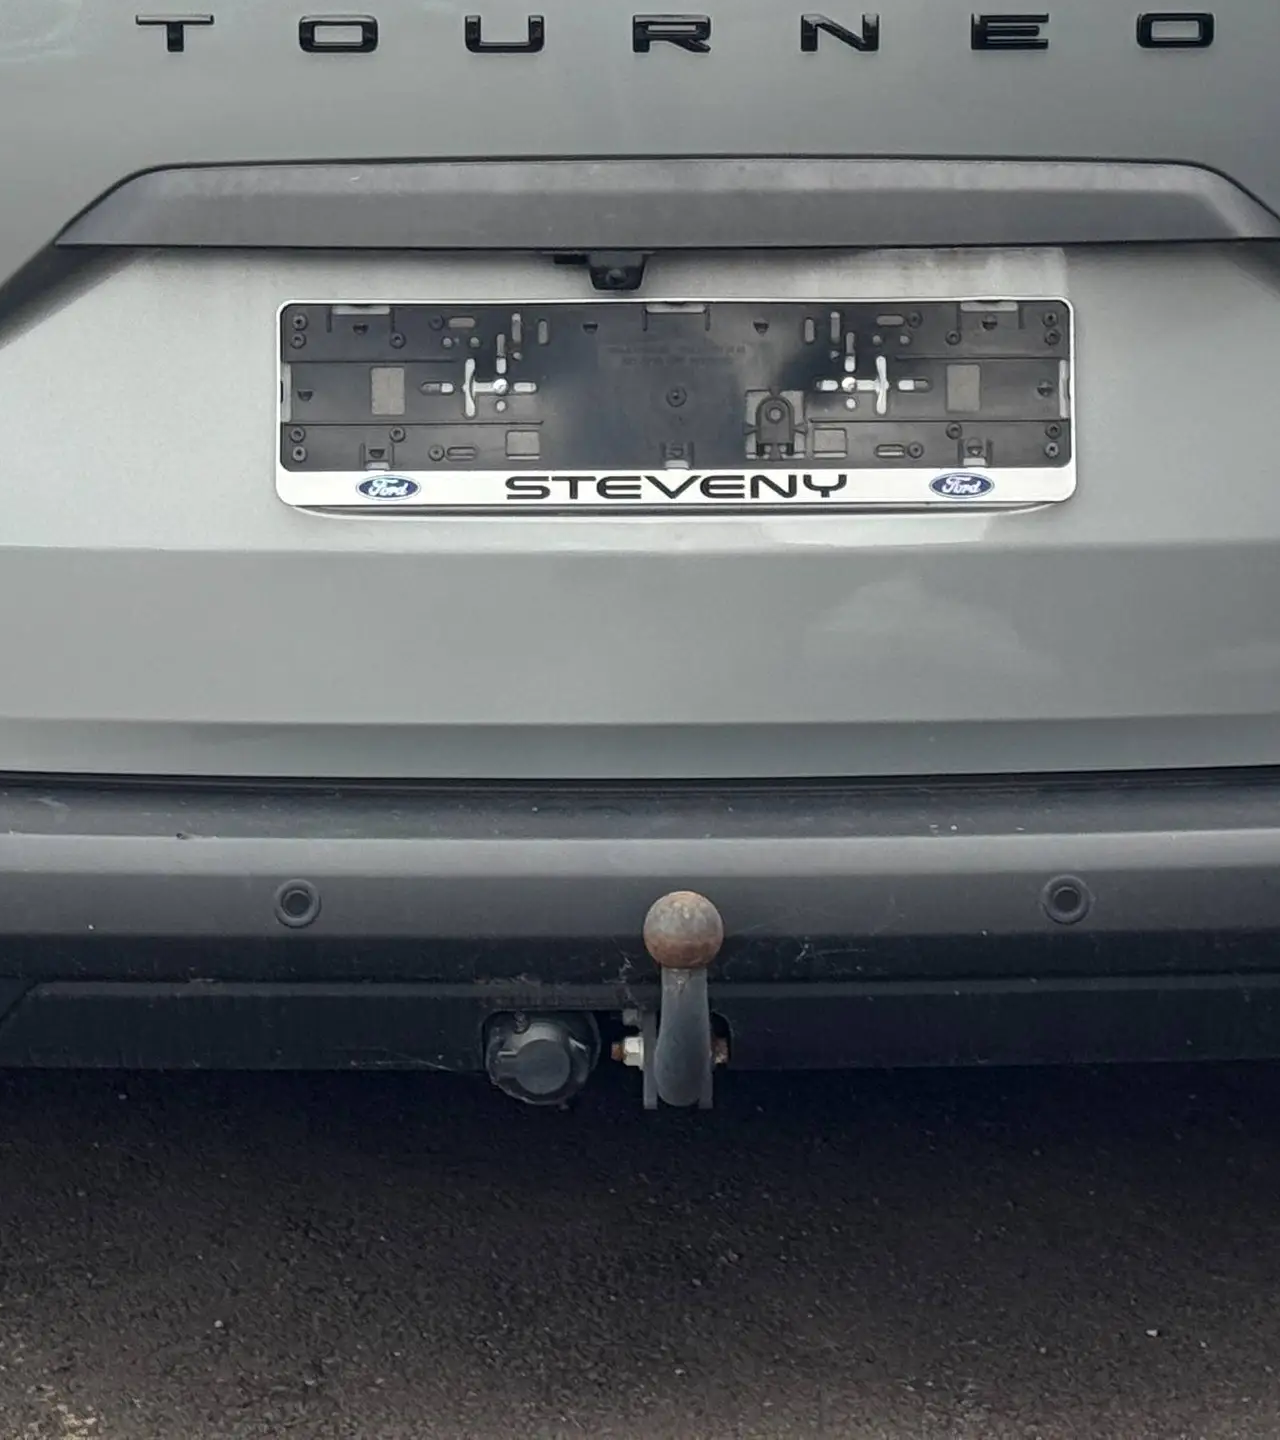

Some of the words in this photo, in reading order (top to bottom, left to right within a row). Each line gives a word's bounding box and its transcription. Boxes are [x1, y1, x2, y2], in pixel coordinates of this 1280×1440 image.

[135, 13, 1214, 52] TOURNEO
[367, 478, 410, 497] Ford
[506, 475, 847, 500] STEVENY
[941, 475, 982, 494] Ford
